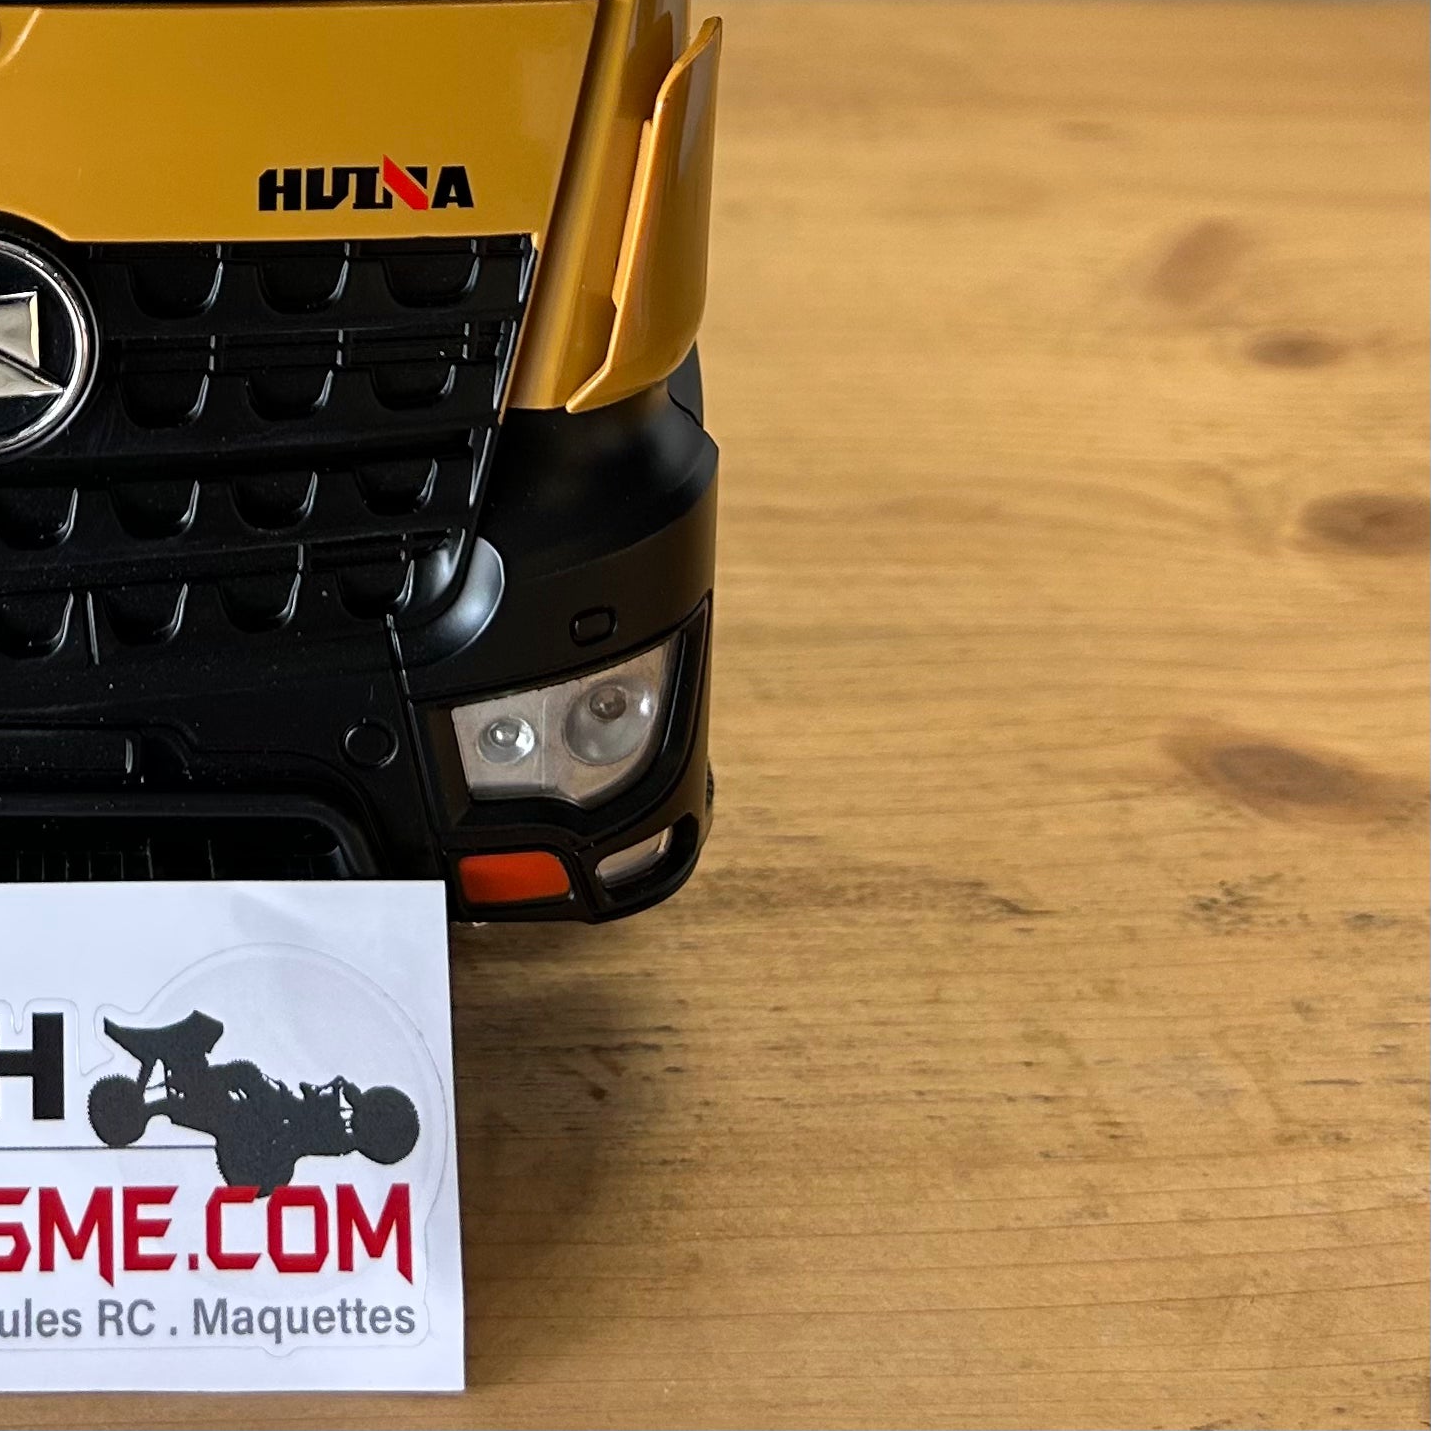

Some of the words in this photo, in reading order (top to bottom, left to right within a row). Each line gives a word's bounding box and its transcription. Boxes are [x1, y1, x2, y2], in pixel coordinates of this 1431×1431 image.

[258, 154, 475, 211] HUINA
[97, 1299, 156, 1337] RC
[193, 1298, 416, 1345] Maquettes
